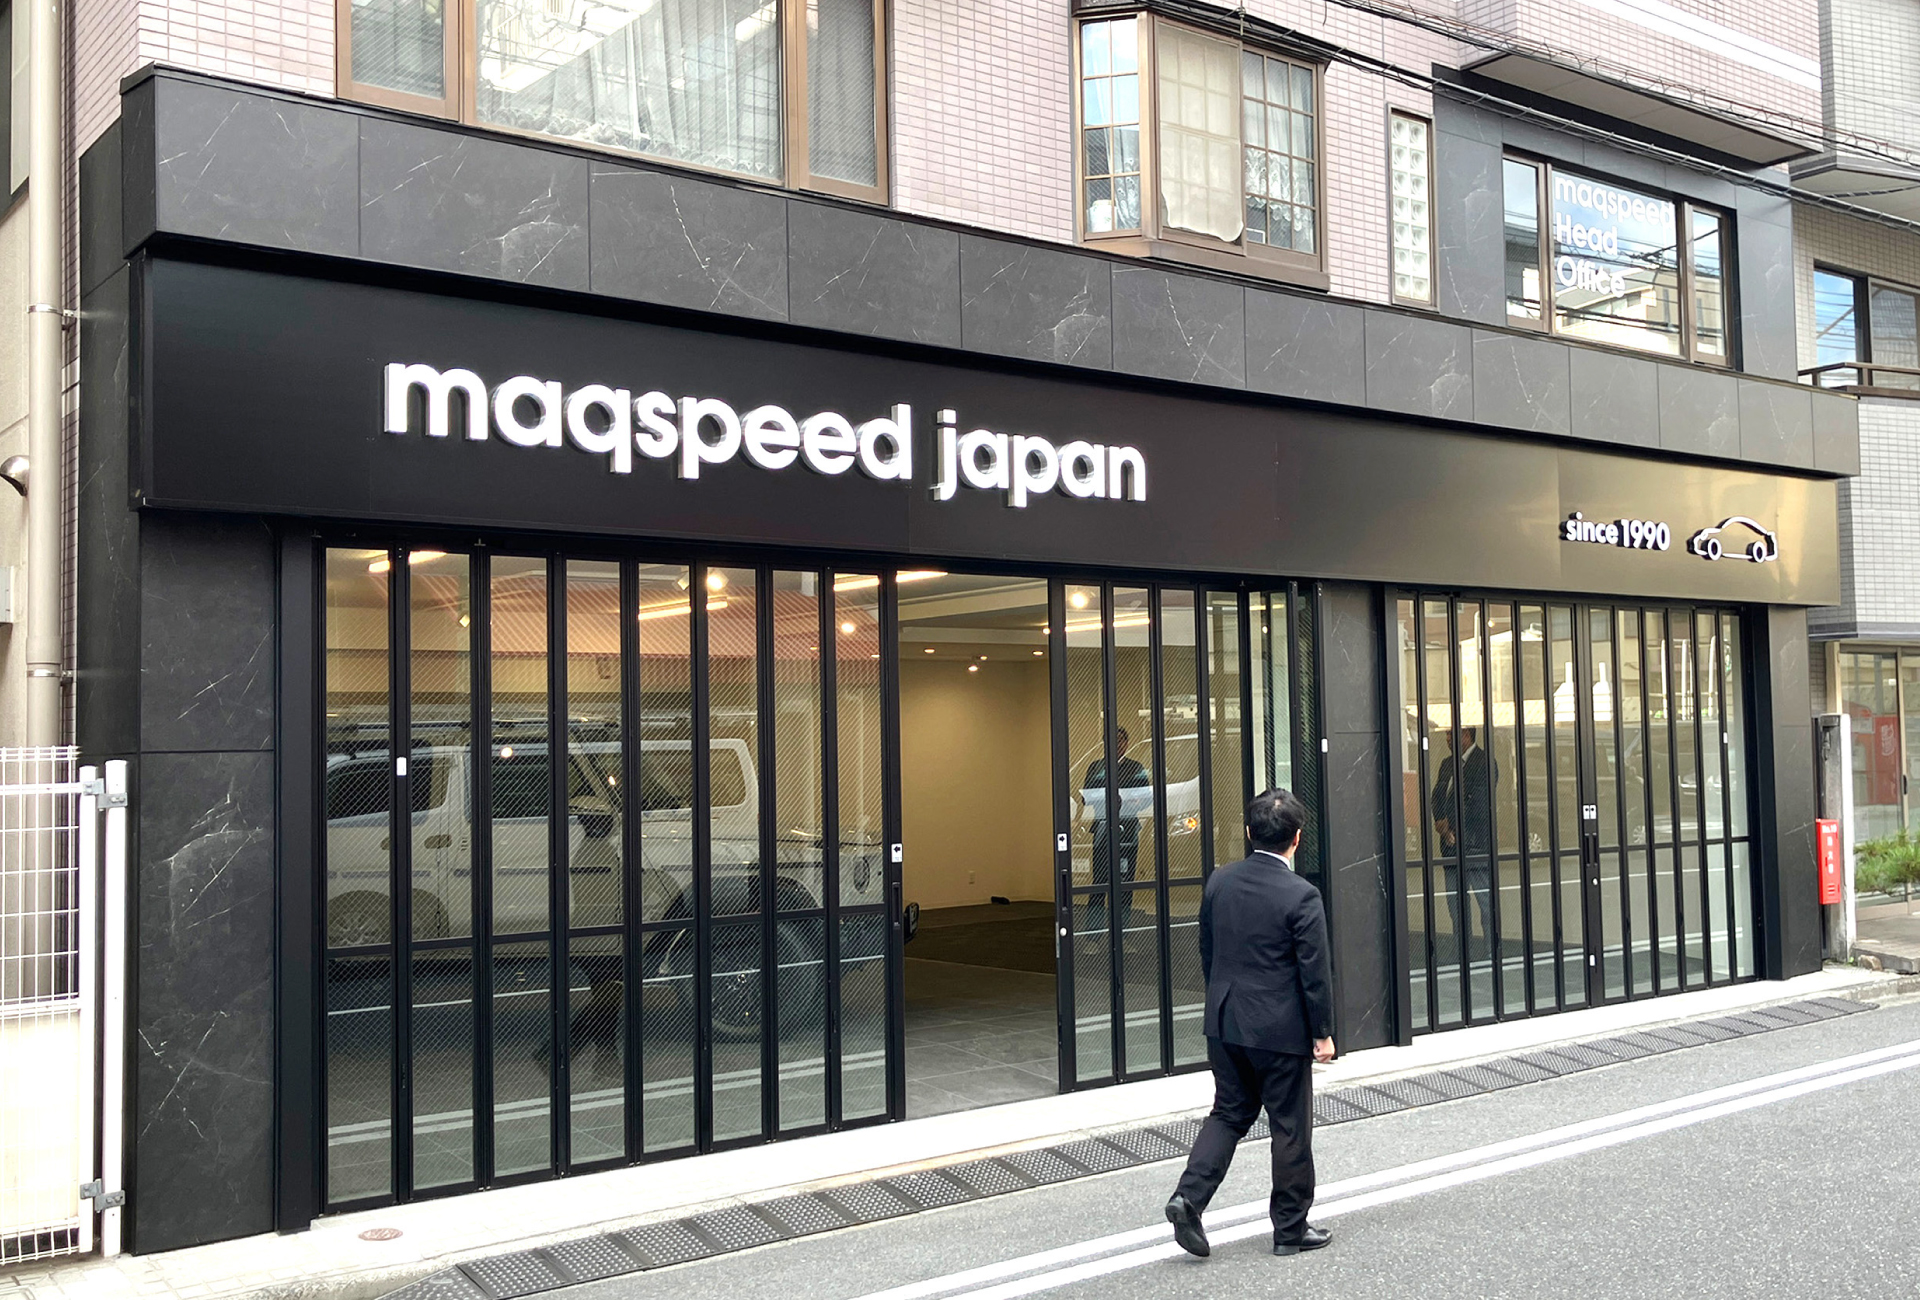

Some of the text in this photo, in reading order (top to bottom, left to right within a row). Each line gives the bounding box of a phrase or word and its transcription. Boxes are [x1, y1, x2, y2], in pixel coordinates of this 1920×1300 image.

[1554, 176, 1675, 229] maqspeed
[1556, 212, 1618, 256] Head
[1557, 255, 1626, 298] Office
[384, 362, 1147, 508] maqspeed japan
